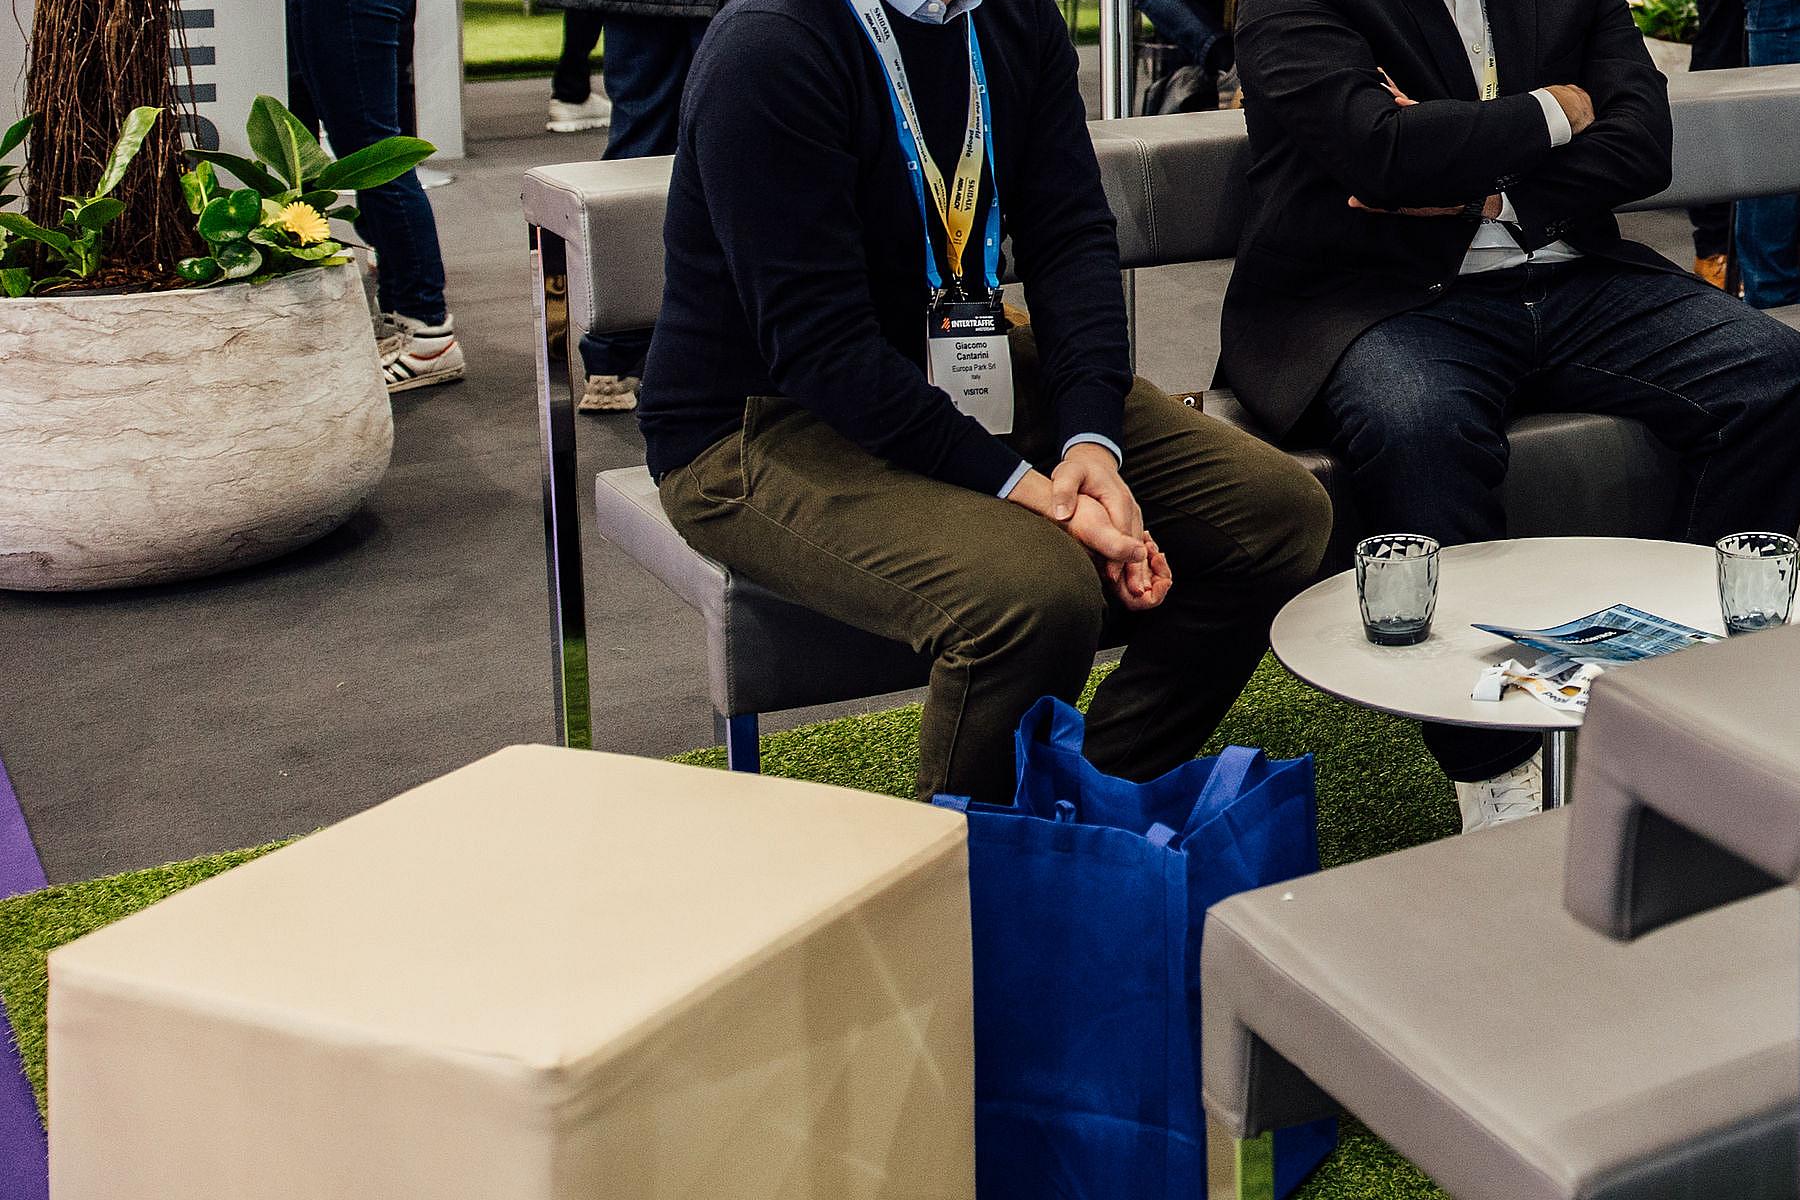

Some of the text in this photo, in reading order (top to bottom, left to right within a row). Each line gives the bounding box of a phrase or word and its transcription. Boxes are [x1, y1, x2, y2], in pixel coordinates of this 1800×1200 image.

[874, 7, 891, 40] SKIDATA
[966, 129, 975, 158] people
[963, 179, 975, 211] SKIDATA
[951, 319, 995, 328] INTERTRAFFIC
[955, 341, 987, 351] Giacomo
[956, 351, 989, 361] Cantarini
[951, 364, 973, 373] Europa
[974, 363, 987, 371] Park
[963, 387, 989, 396] VISITOR
